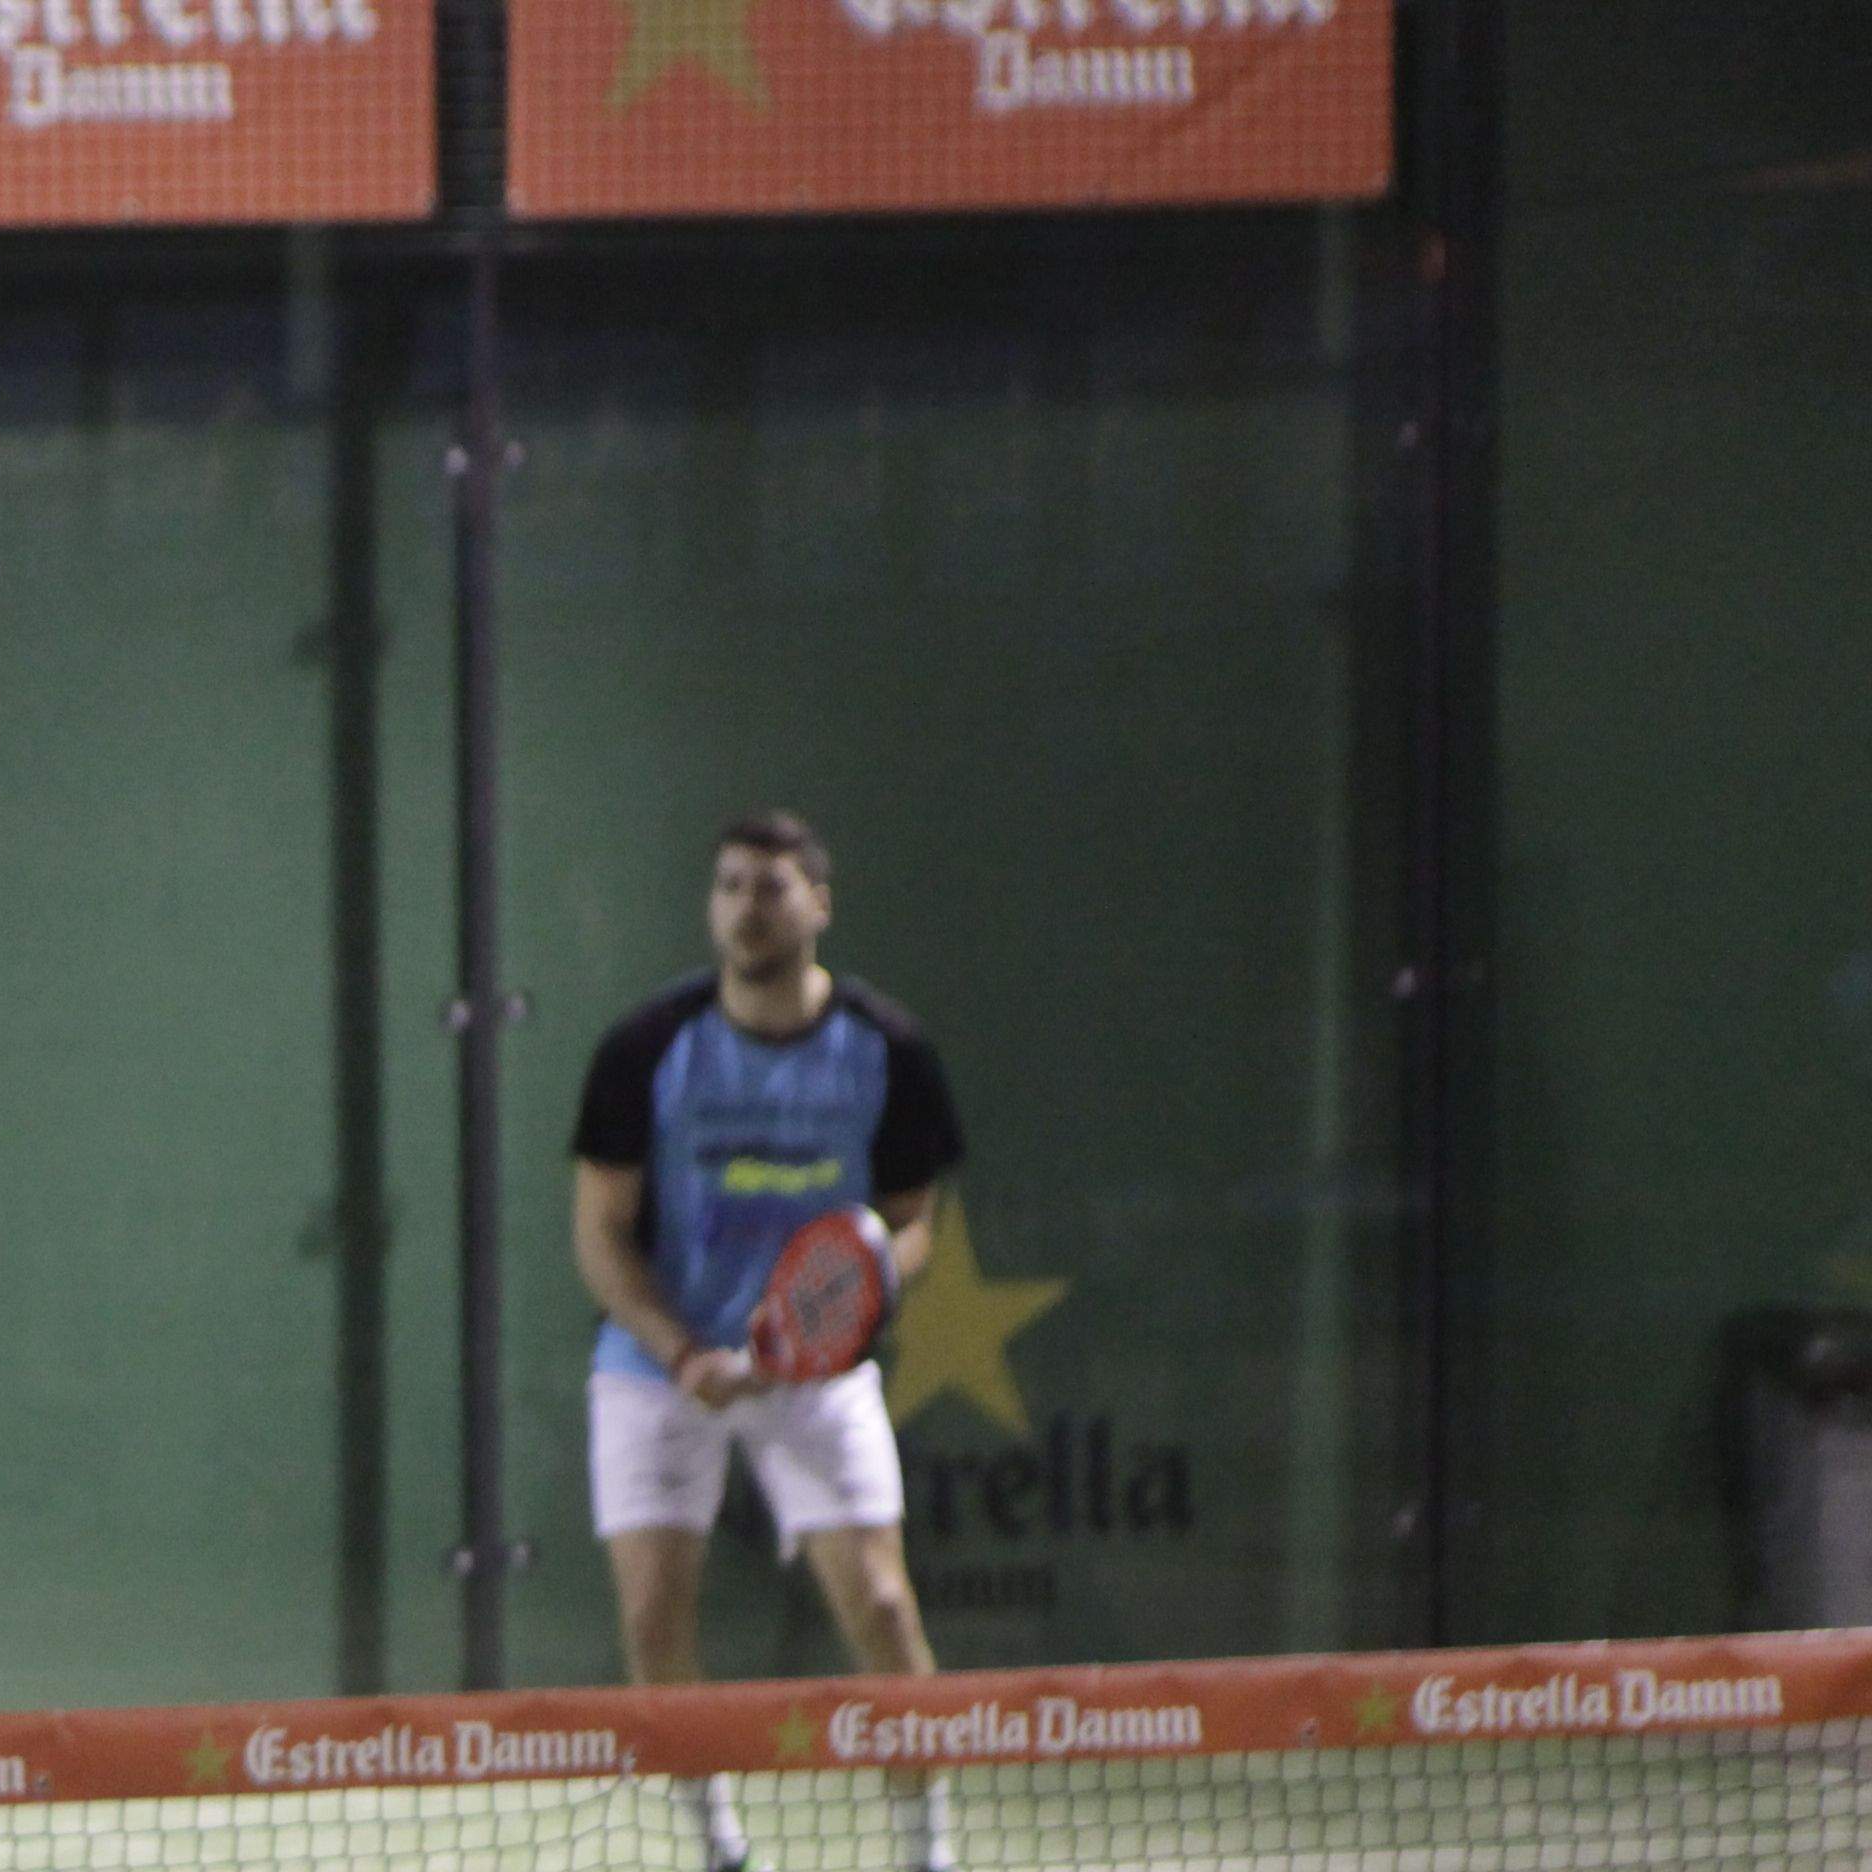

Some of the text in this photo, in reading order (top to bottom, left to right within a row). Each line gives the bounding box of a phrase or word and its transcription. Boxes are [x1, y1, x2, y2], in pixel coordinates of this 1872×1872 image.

[8, 42, 233, 129] Damm
[972, 26, 1195, 116] Damm
[924, 1410, 1196, 1538] rella
[828, 1696, 1203, 1759] Estrella Damm
[1411, 1668, 1784, 1734] Estrella Damm
[243, 1719, 618, 1784] Estrella Damm
